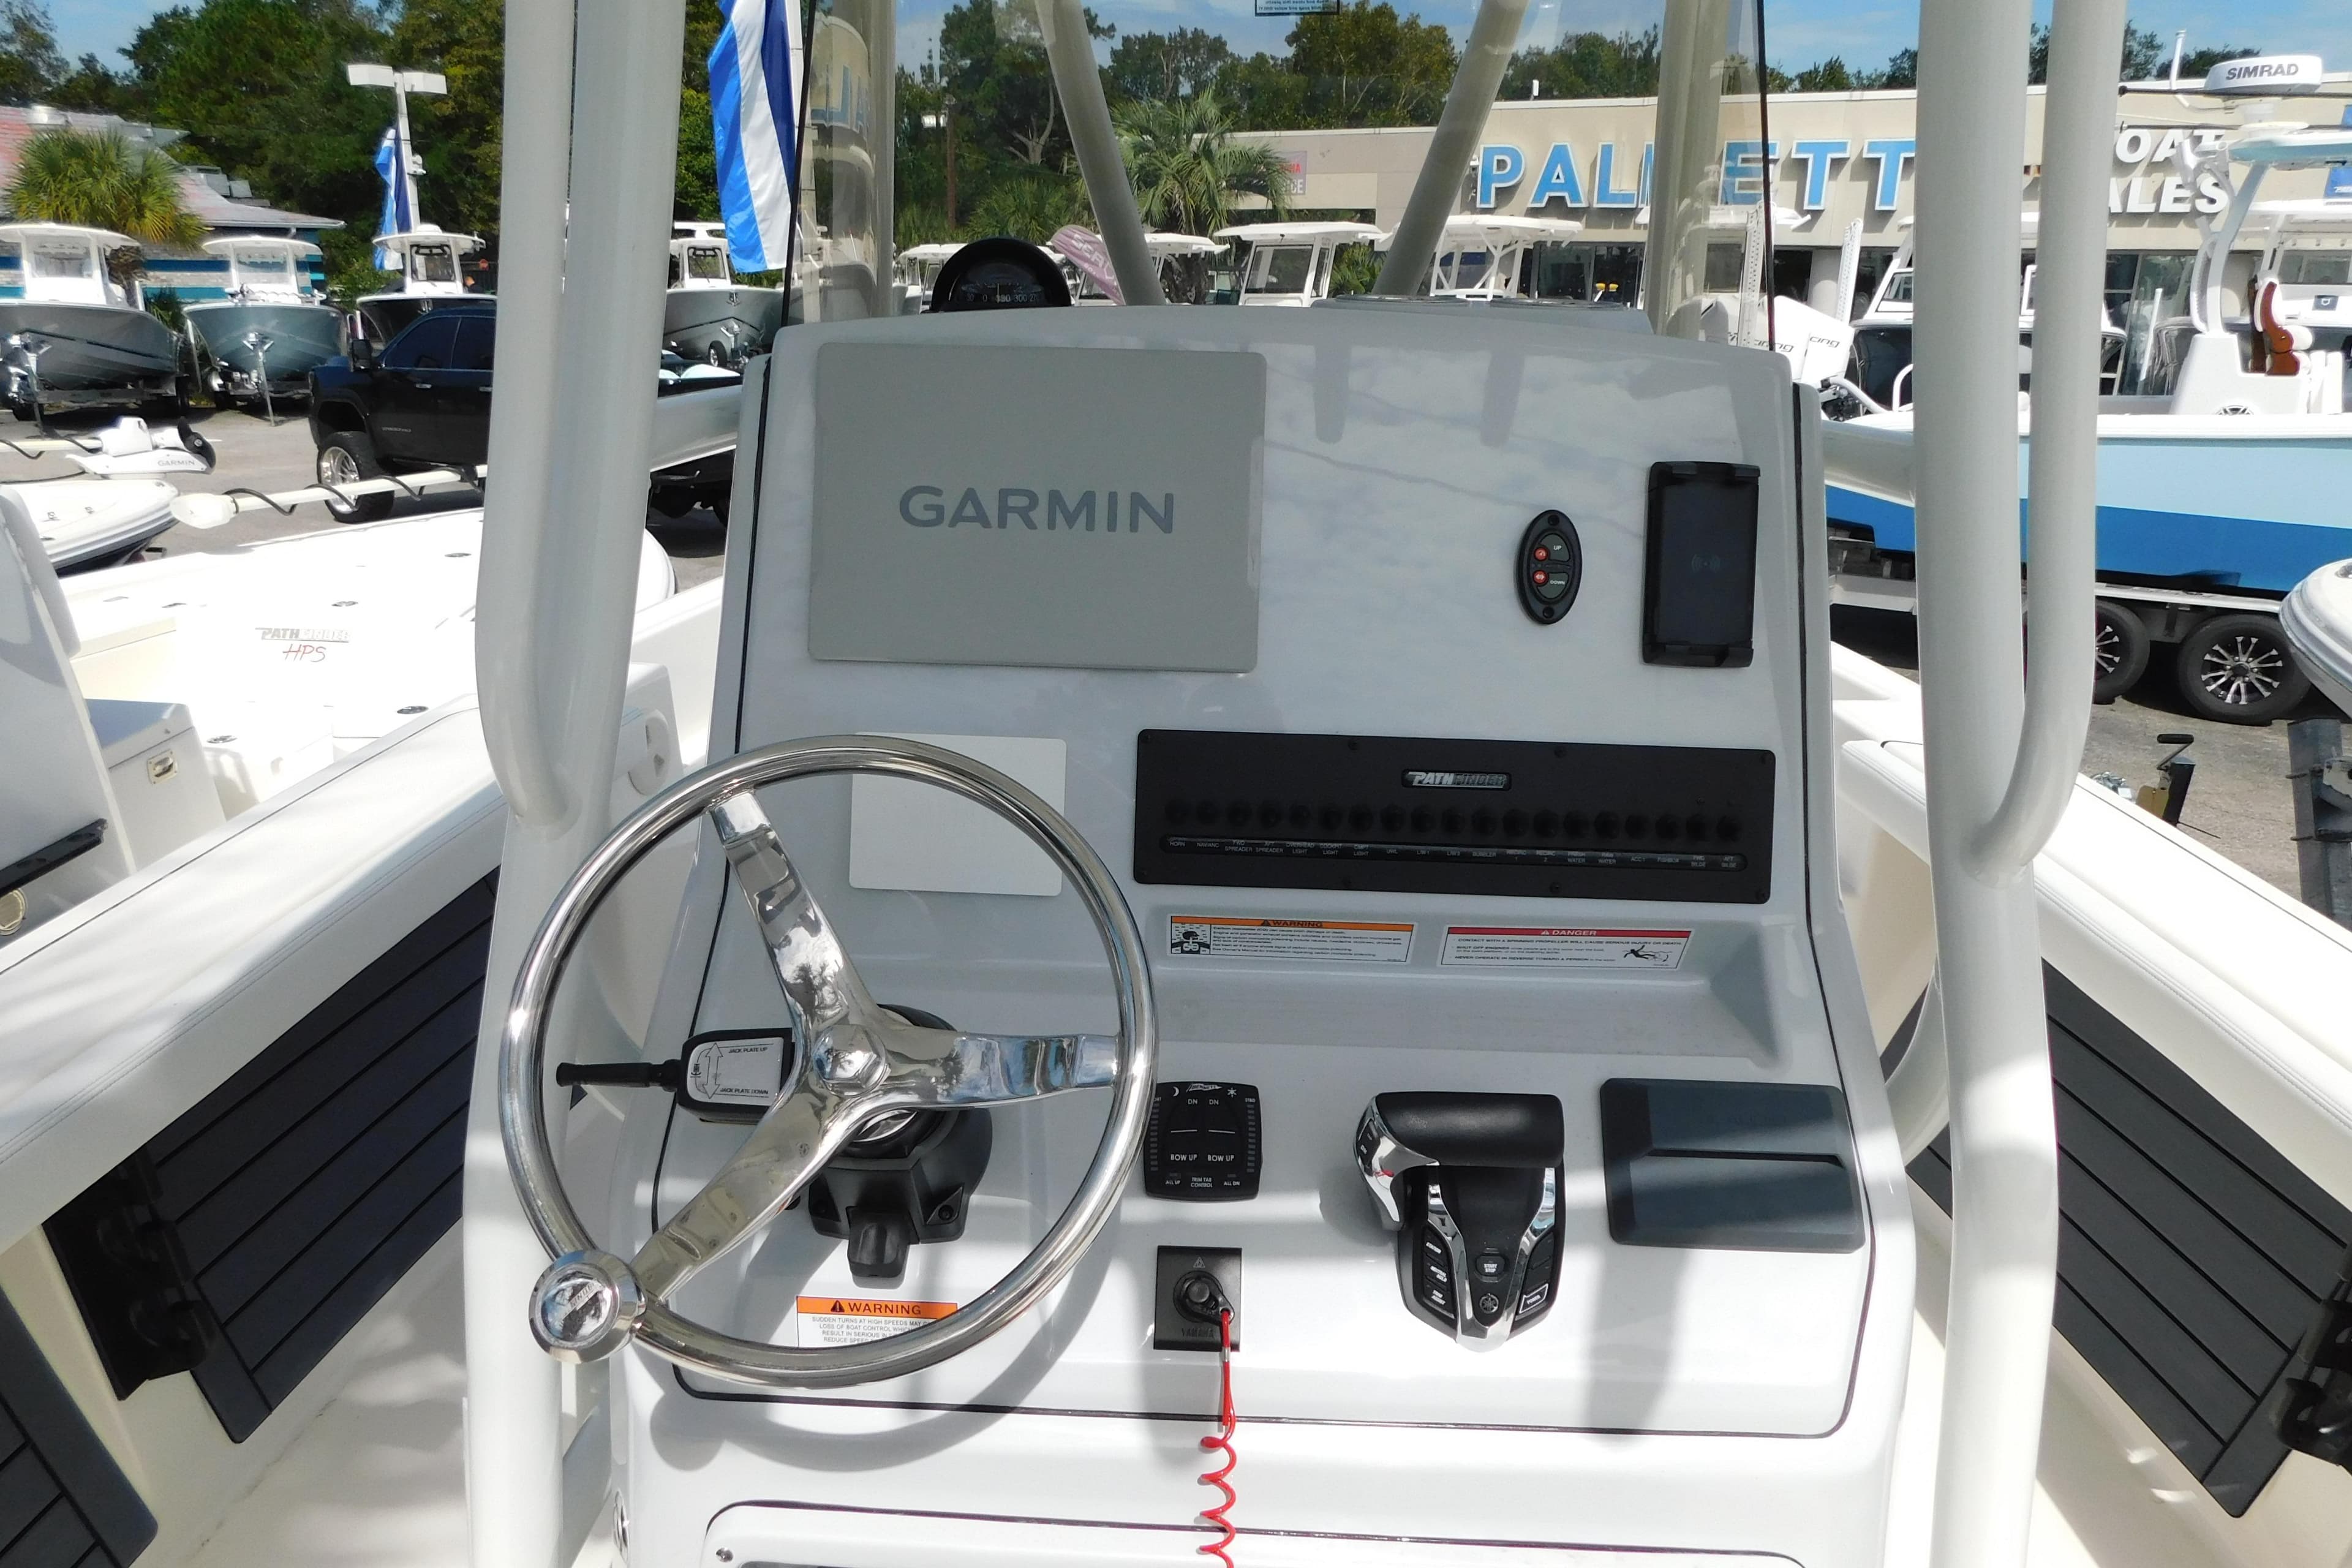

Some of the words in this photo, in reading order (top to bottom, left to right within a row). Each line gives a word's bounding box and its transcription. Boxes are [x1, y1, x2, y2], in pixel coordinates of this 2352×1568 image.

[2225, 62, 2299, 81] SIMRAD
[2115, 129, 2225, 163] OAT
[1476, 138, 1915, 212] PALETT
[899, 484, 1174, 534] GARMIN
[282, 644, 326, 663] HPS
[848, 1302, 921, 1315] WARNING
